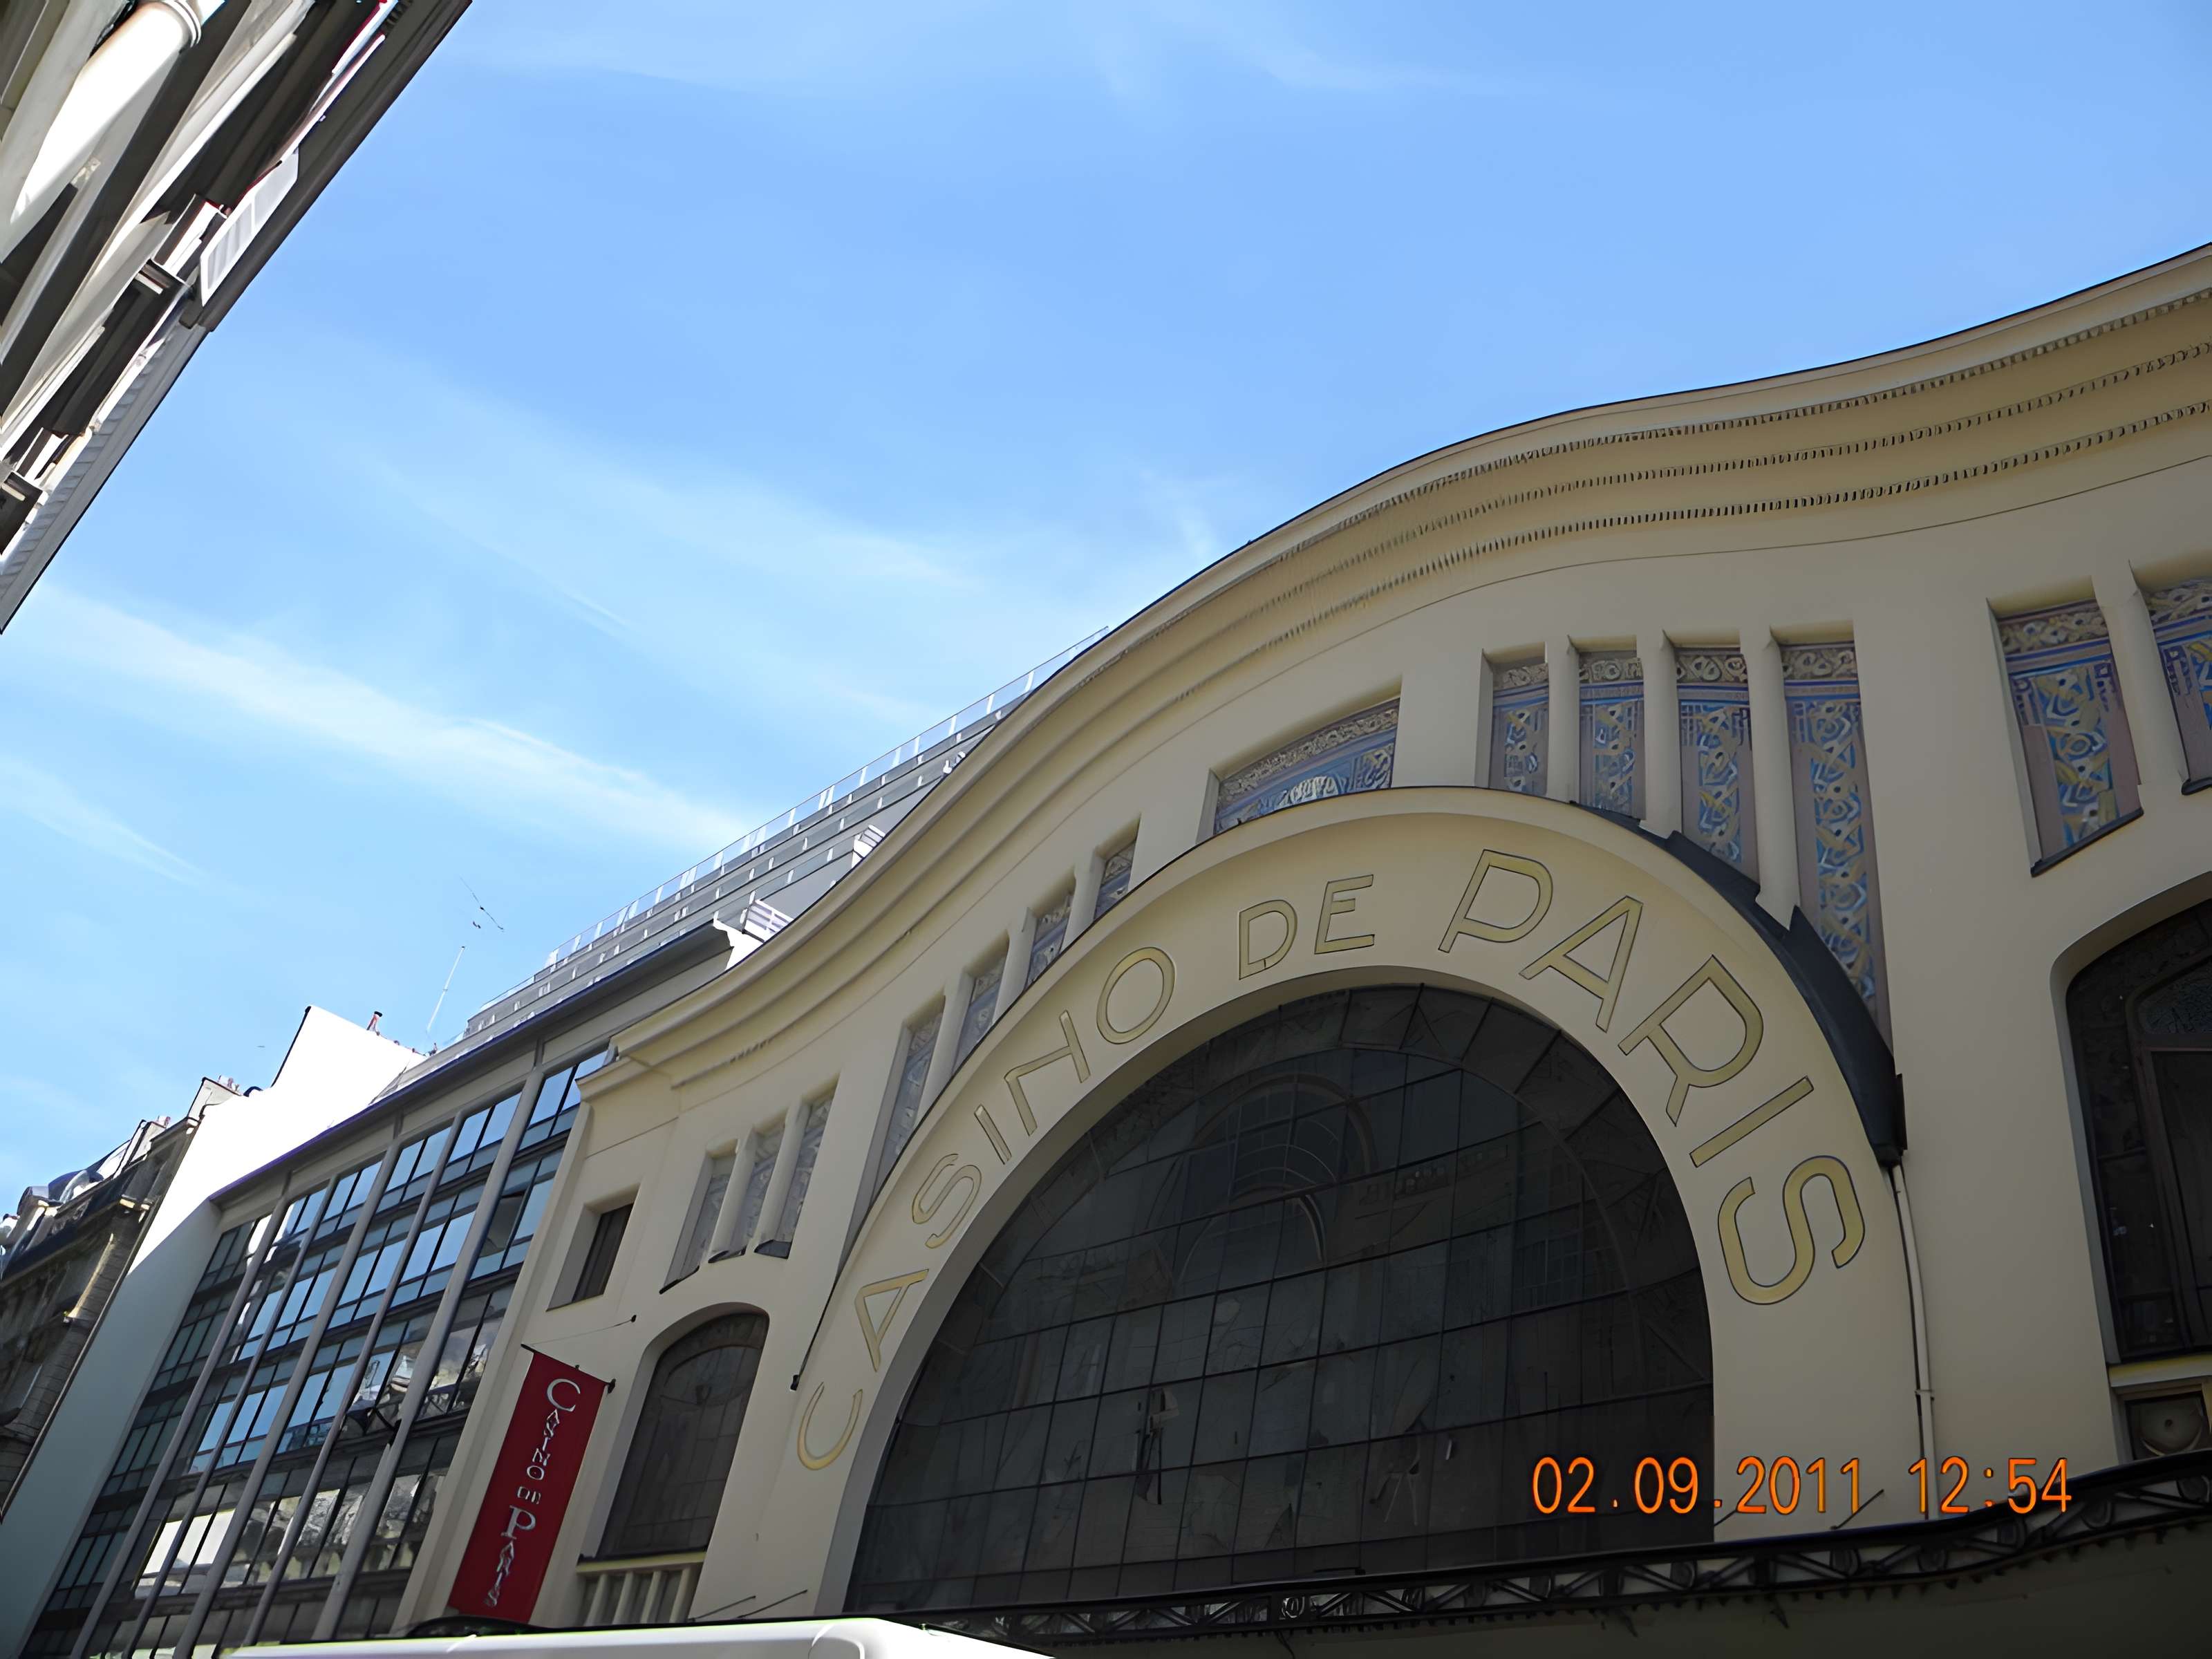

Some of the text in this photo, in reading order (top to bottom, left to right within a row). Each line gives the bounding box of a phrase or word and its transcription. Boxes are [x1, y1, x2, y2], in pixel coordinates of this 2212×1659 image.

[796, 849, 1866, 1472] CASINO DE PARIS
